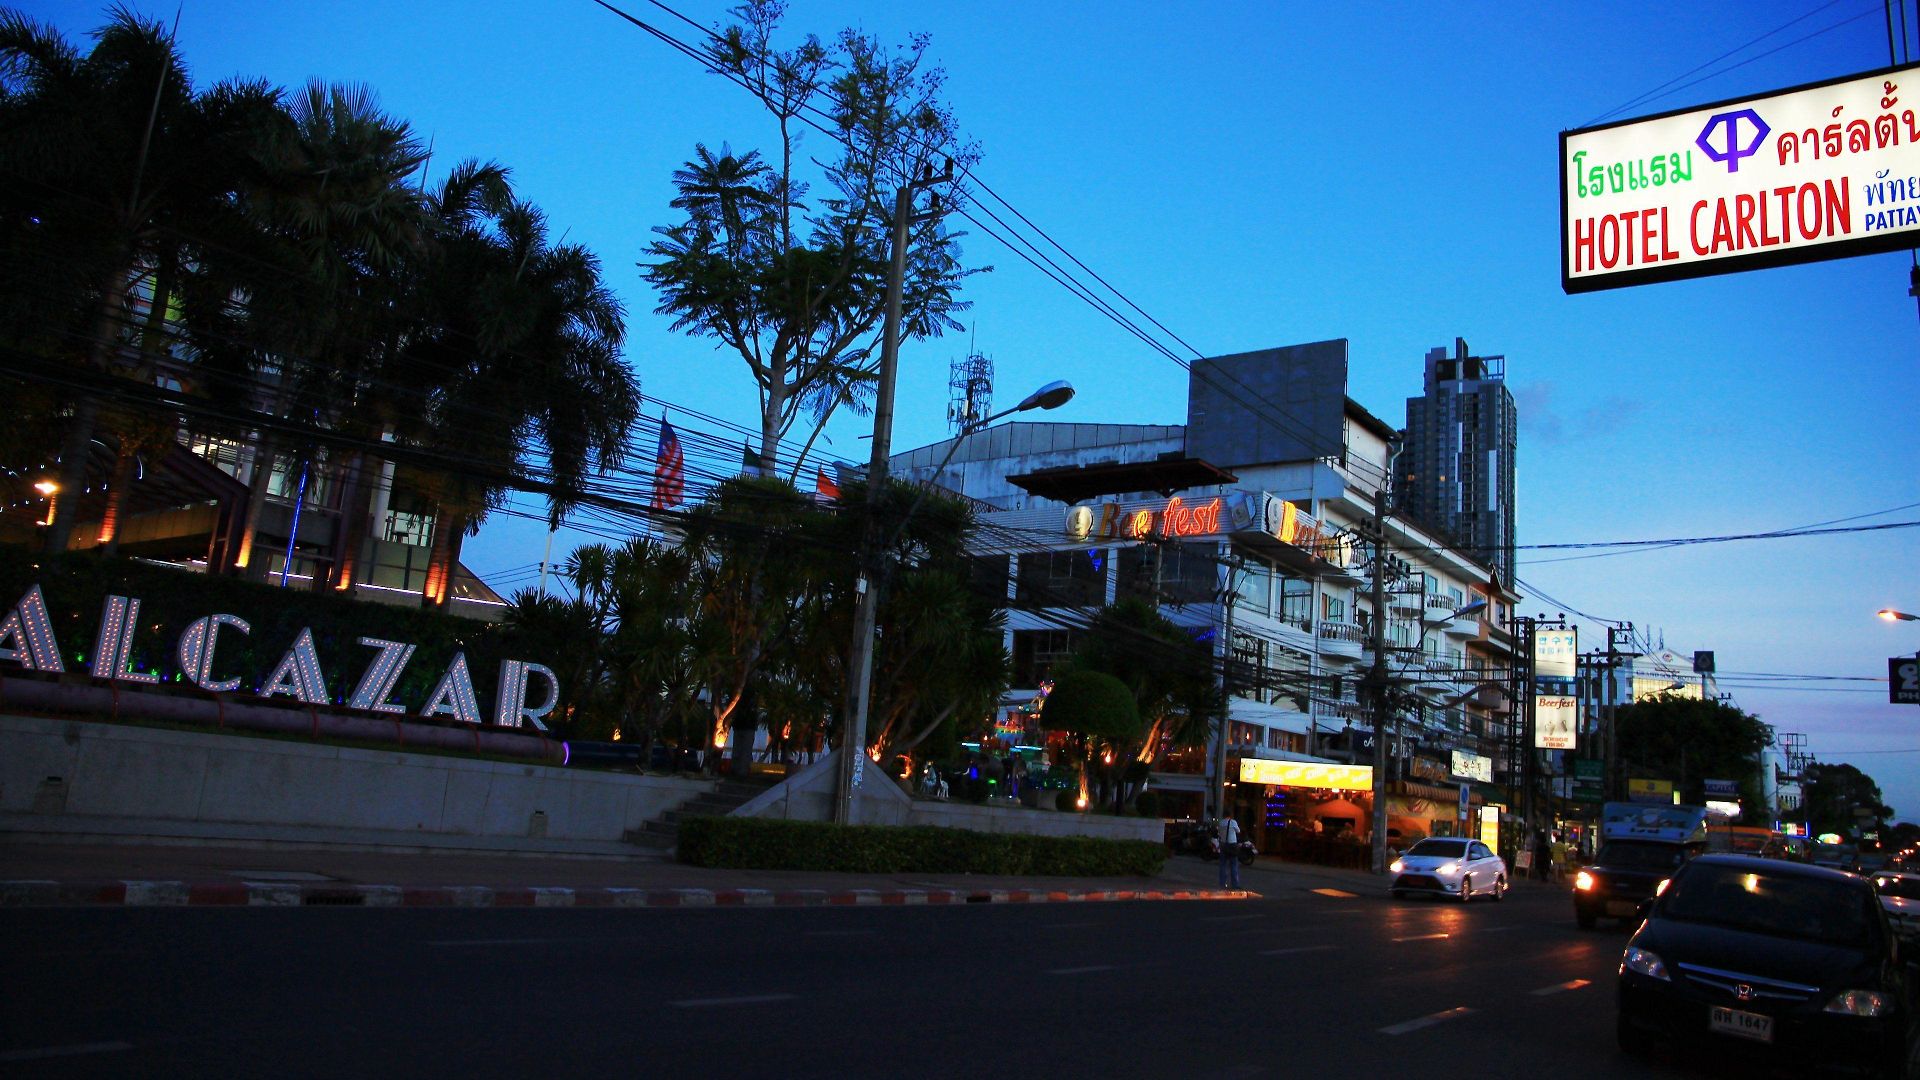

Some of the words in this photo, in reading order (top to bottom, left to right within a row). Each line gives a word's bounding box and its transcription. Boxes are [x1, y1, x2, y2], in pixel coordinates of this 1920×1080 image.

[1572, 149, 1692, 198] โรงแรม
[1575, 205, 1680, 273] HOTEL
[1690, 175, 1852, 257] CARLTON
[1100, 495, 1221, 541] Beerfest
[0, 582, 561, 732] ALCAZAR
[1538, 697, 1575, 710] Beerfest
[1739, 1014, 1769, 1031] 1647
